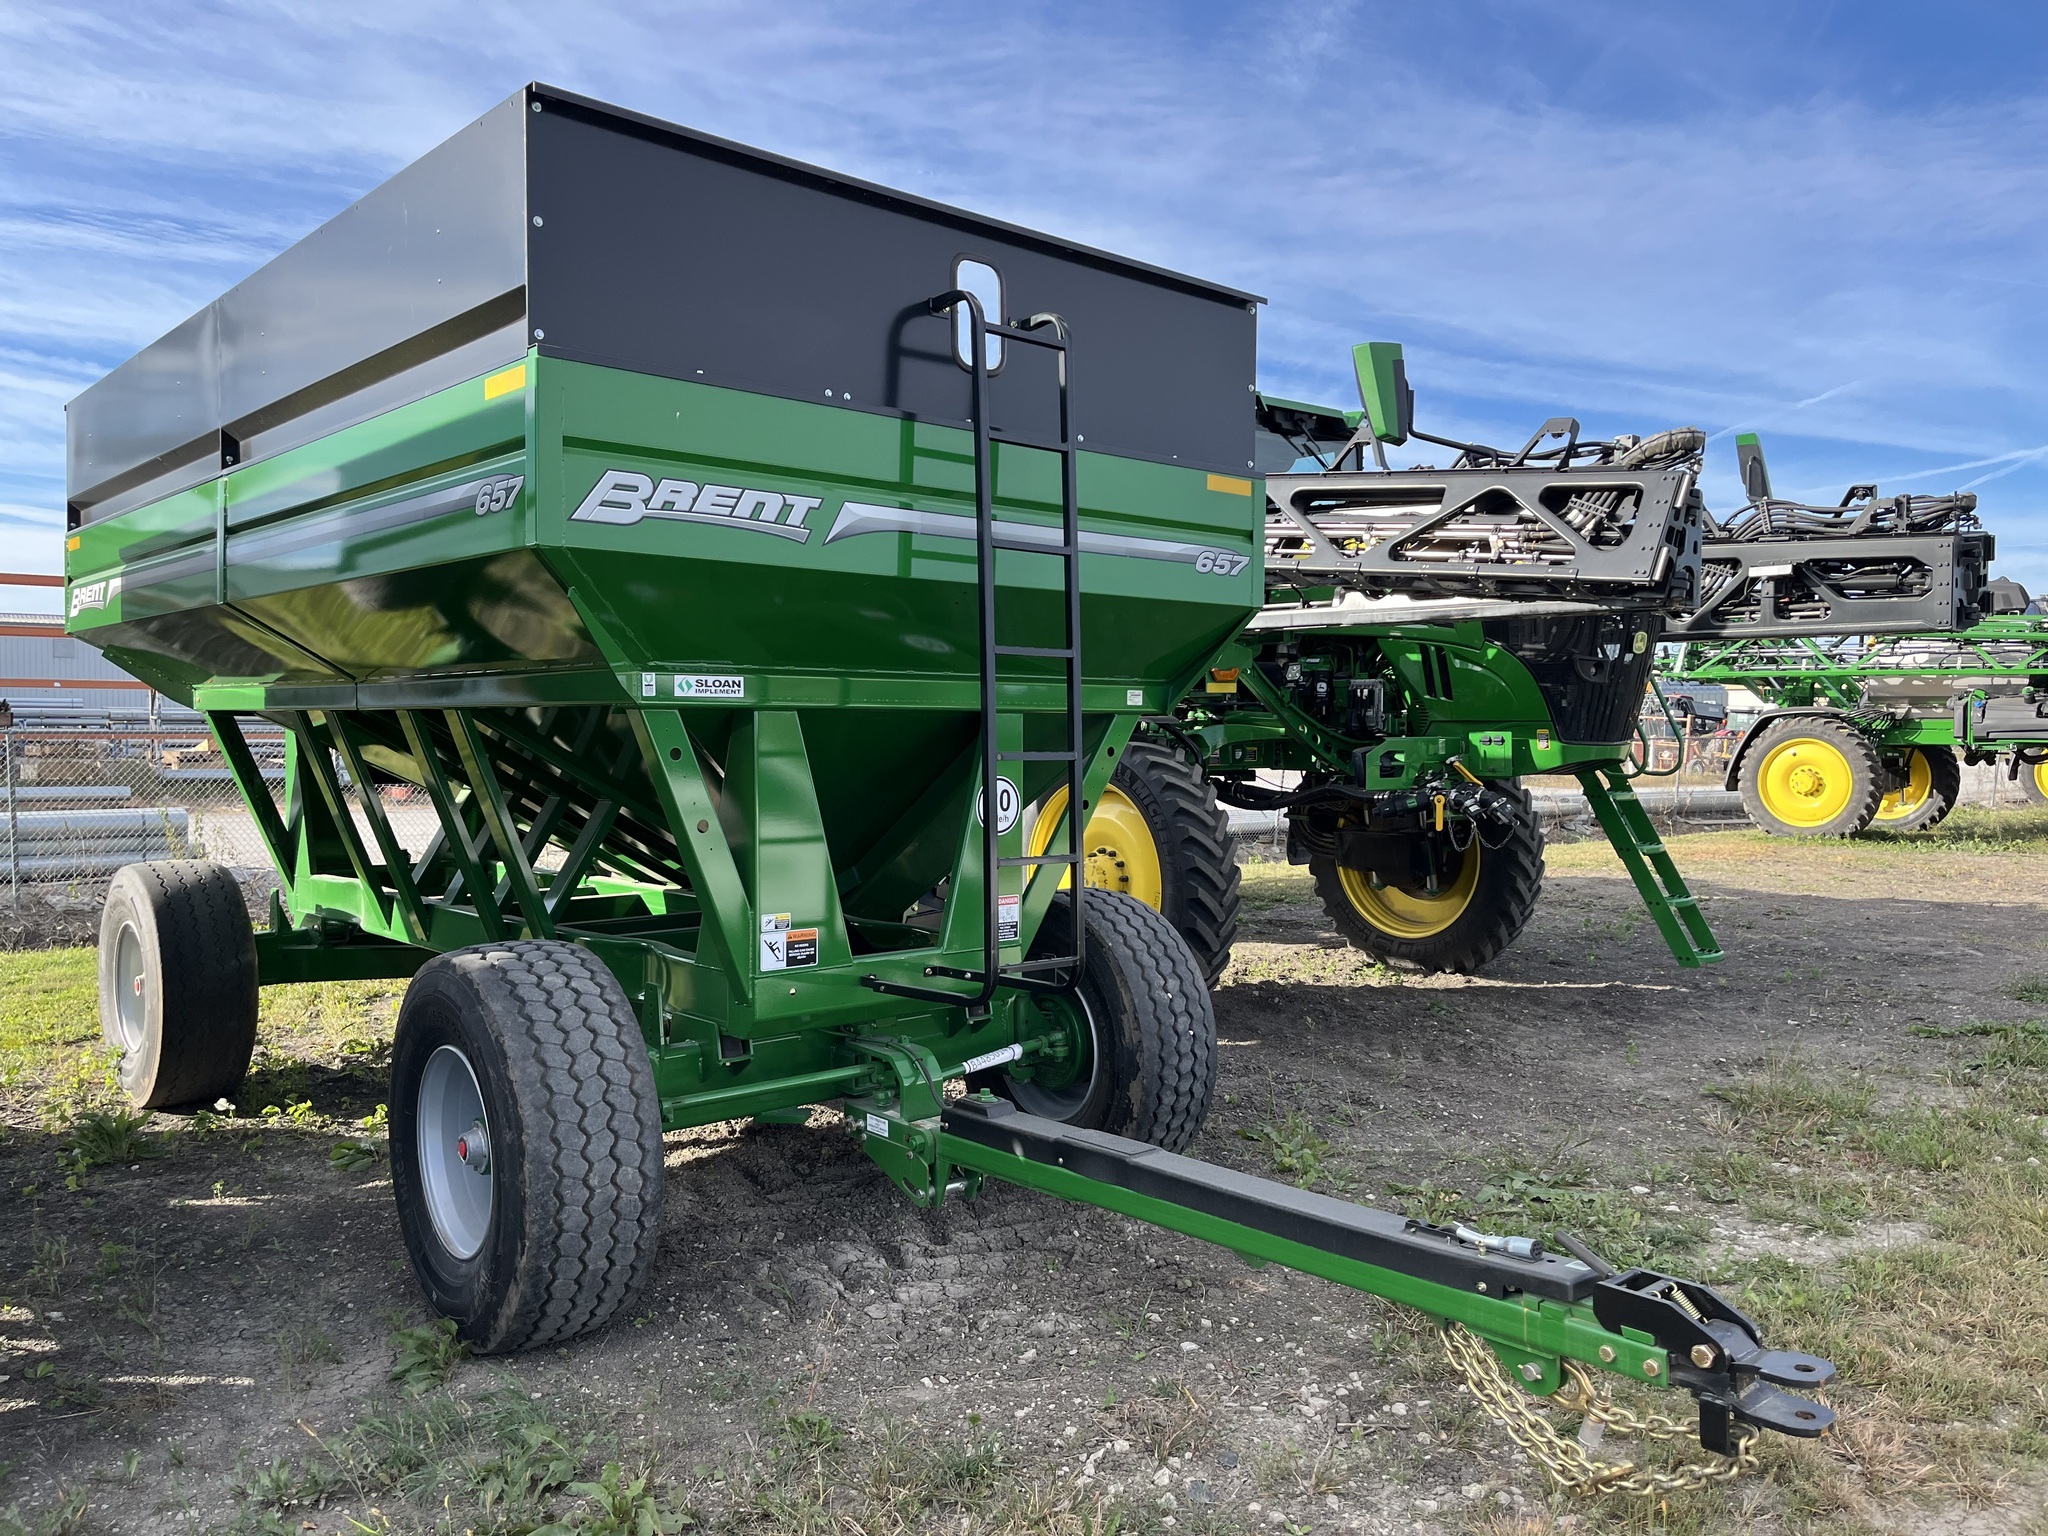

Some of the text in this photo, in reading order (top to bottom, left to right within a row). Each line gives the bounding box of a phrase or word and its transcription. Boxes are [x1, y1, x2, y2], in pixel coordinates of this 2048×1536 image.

[475, 474, 525, 517] 657
[567, 469, 825, 529] BRENT
[1195, 550, 1251, 577] 657
[69, 580, 107, 618] BRENT
[695, 679, 741, 689] SLOAN
[792, 931, 817, 940] WARNING
